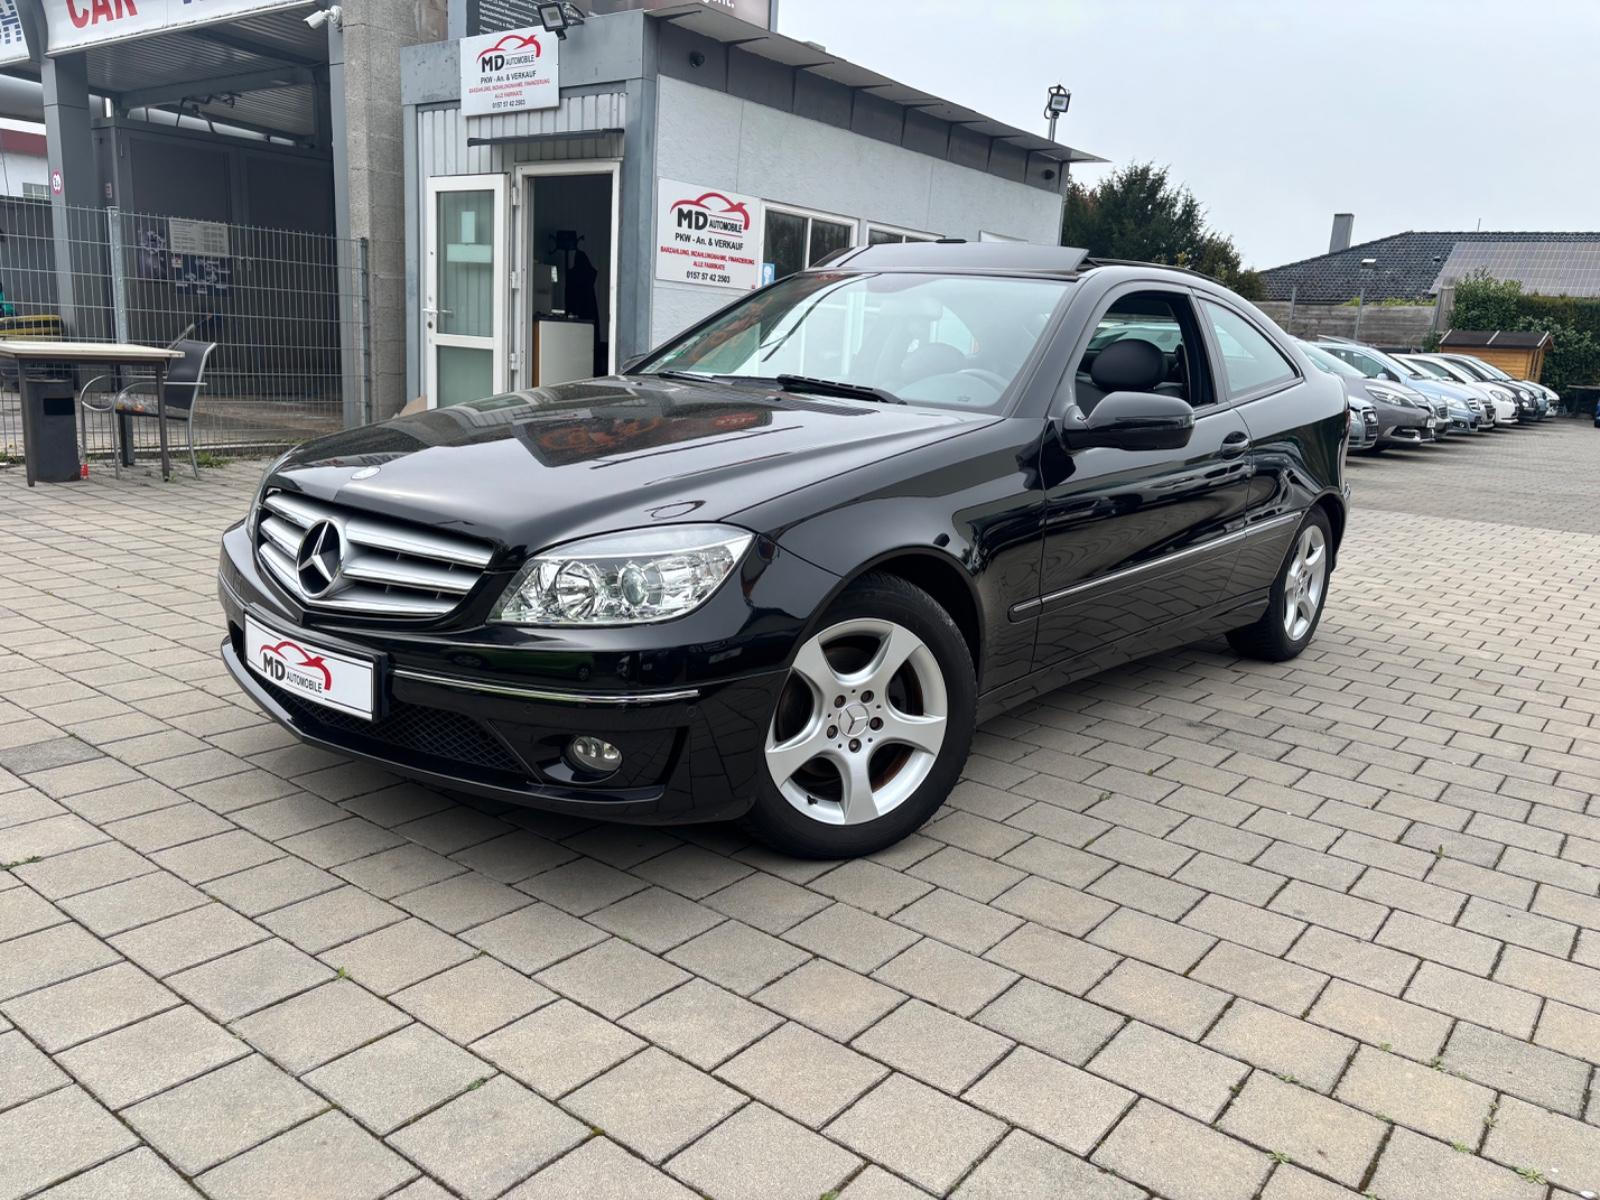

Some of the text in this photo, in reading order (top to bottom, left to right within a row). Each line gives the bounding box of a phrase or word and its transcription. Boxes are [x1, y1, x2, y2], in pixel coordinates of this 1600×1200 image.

[481, 54, 535, 73] MD AUTOMOBILE
[480, 76, 493, 84] PKW
[511, 70, 536, 80] VERKAUF
[677, 207, 743, 234] MD AUTOMOBILE
[675, 232, 691, 243] PKW
[695, 236, 707, 246] An.
[708, 237, 713, 247] &
[714, 238, 744, 251] VERKAUF
[704, 262, 725, 271] FABRIKATE
[686, 270, 730, 283] 0157 57 42 2503
[263, 652, 323, 693] MD AUTOMOBILE
